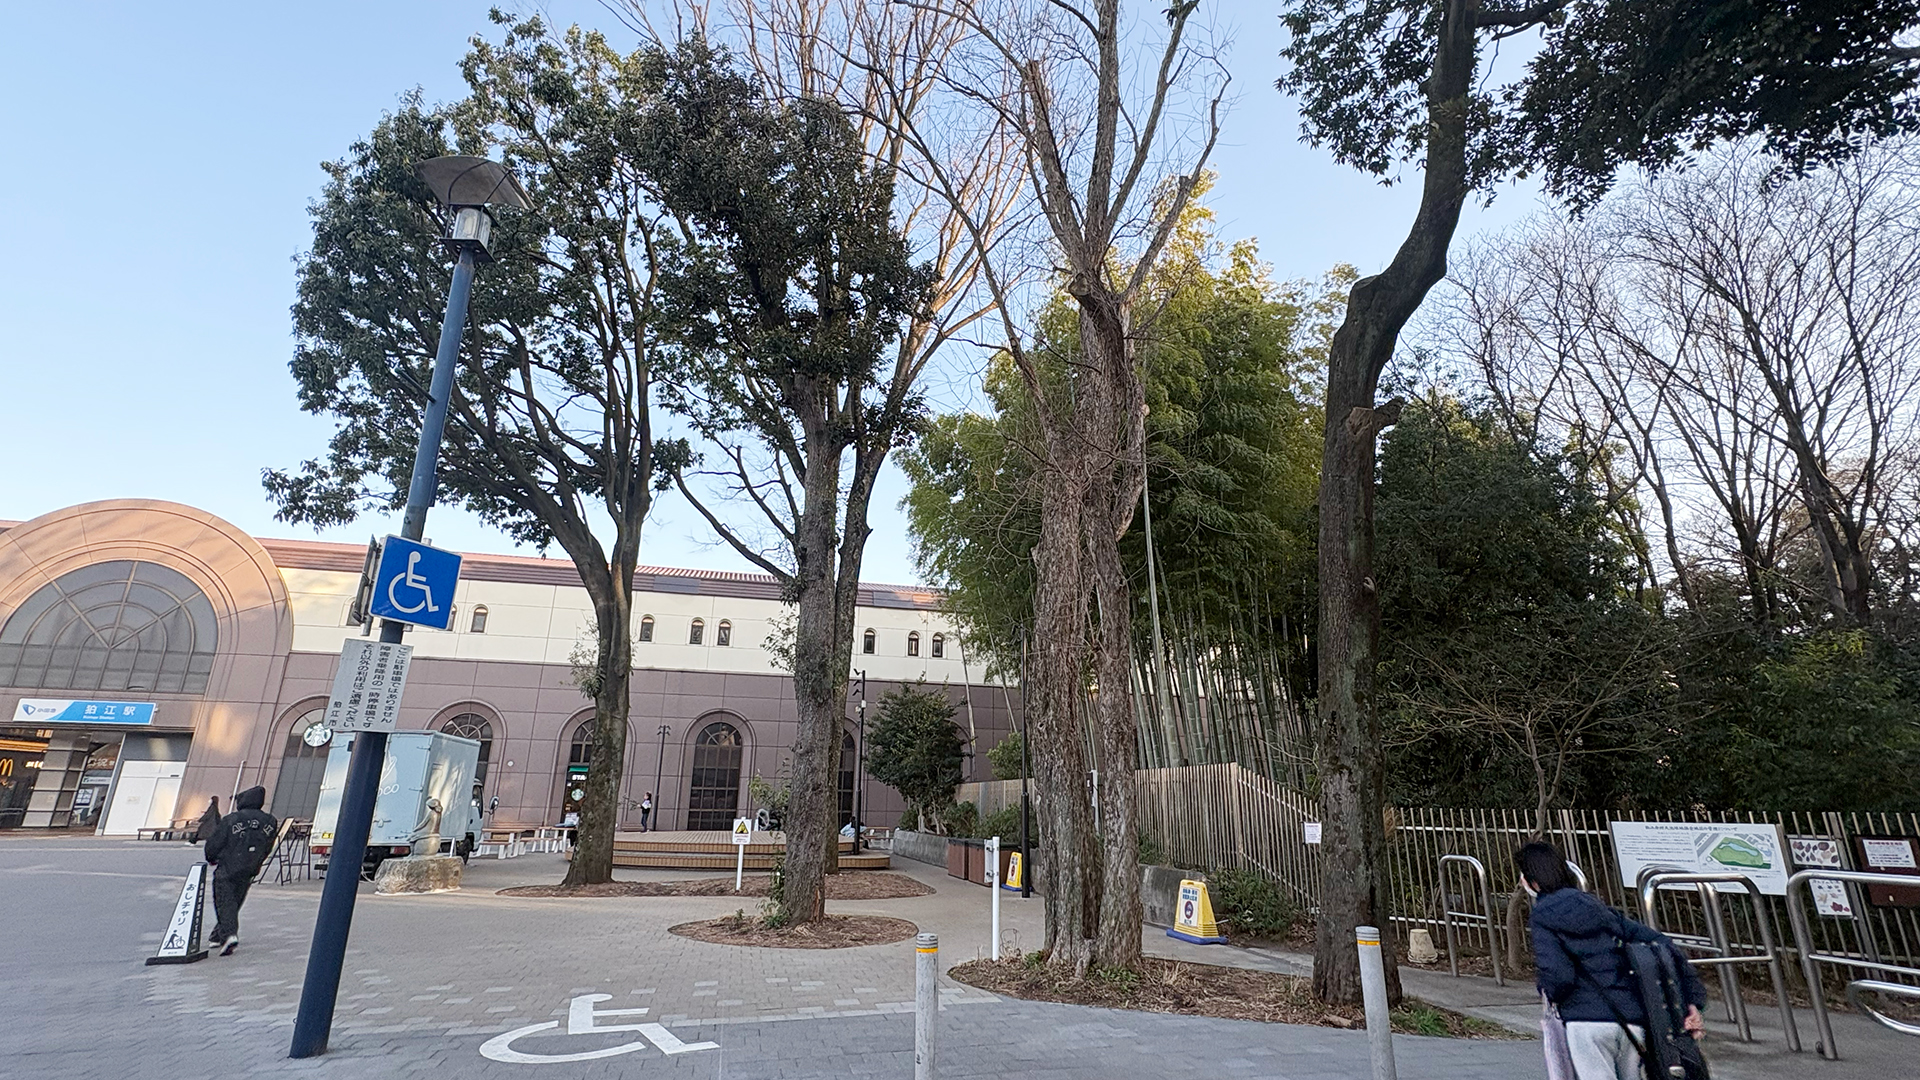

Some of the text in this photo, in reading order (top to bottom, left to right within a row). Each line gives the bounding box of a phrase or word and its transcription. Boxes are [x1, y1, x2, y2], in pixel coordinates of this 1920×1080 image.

[84, 704, 136, 716] 狛江駅
[328, 701, 342, 726] 狛江市
[343, 644, 373, 728] それ以外の利用はご遠慮ください
[362, 645, 391, 728] 障害者乗降用の一時停車場です
[380, 647, 407, 724] ここは駐車場ではありません
[177, 883, 197, 926] おしチャリ
